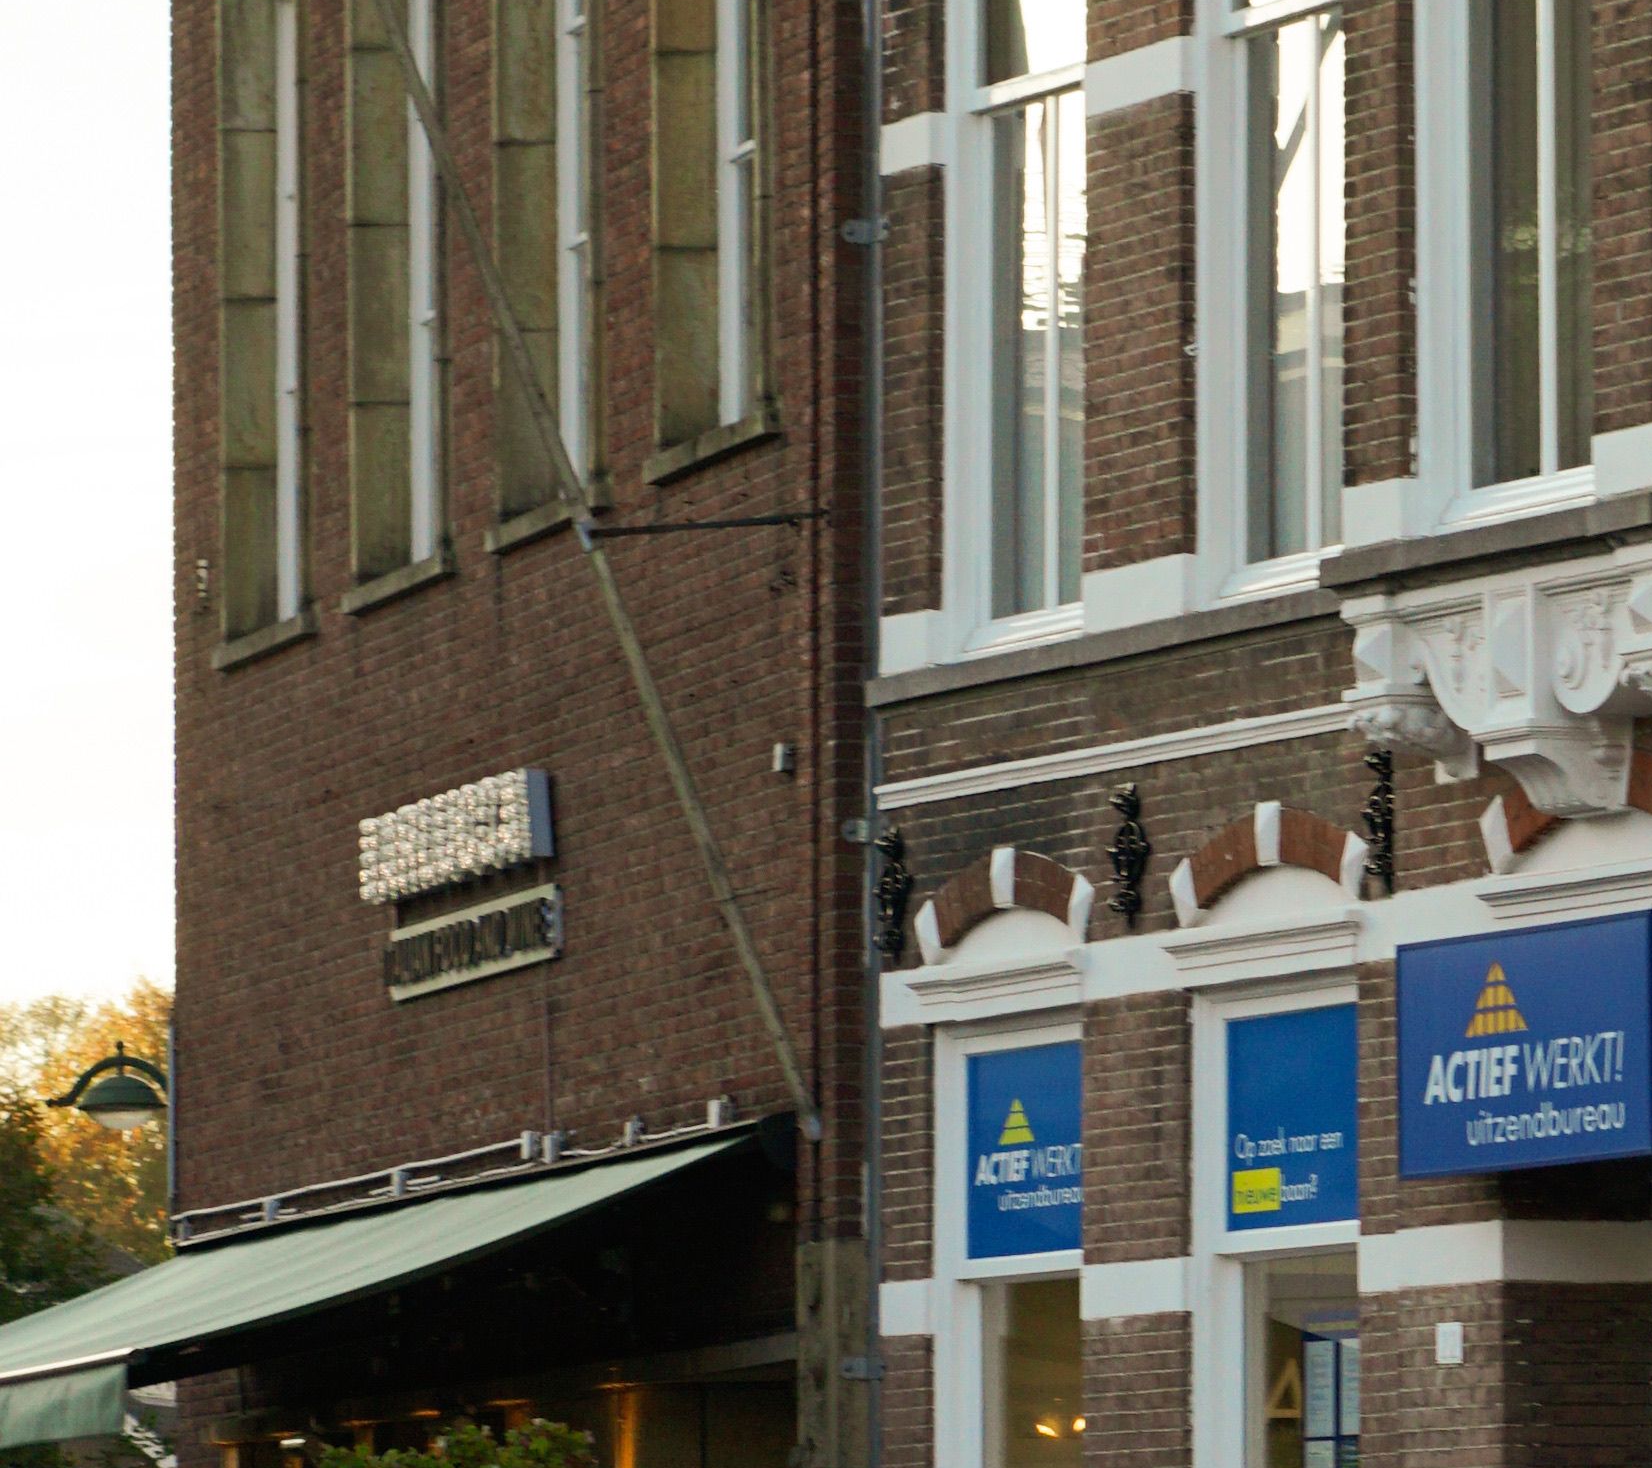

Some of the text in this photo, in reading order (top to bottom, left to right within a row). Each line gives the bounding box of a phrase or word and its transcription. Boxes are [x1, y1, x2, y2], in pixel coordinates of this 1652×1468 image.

[1424, 1030, 1625, 1106] ACTIEF WERKT!
[1466, 1101, 1626, 1147] uitzendbureau
[974, 1149, 1030, 1186] ACTIEF
[1234, 1133, 1257, 1166] Op
[1257, 1126, 1287, 1157] zoek
[1319, 1131, 1344, 1150] een
